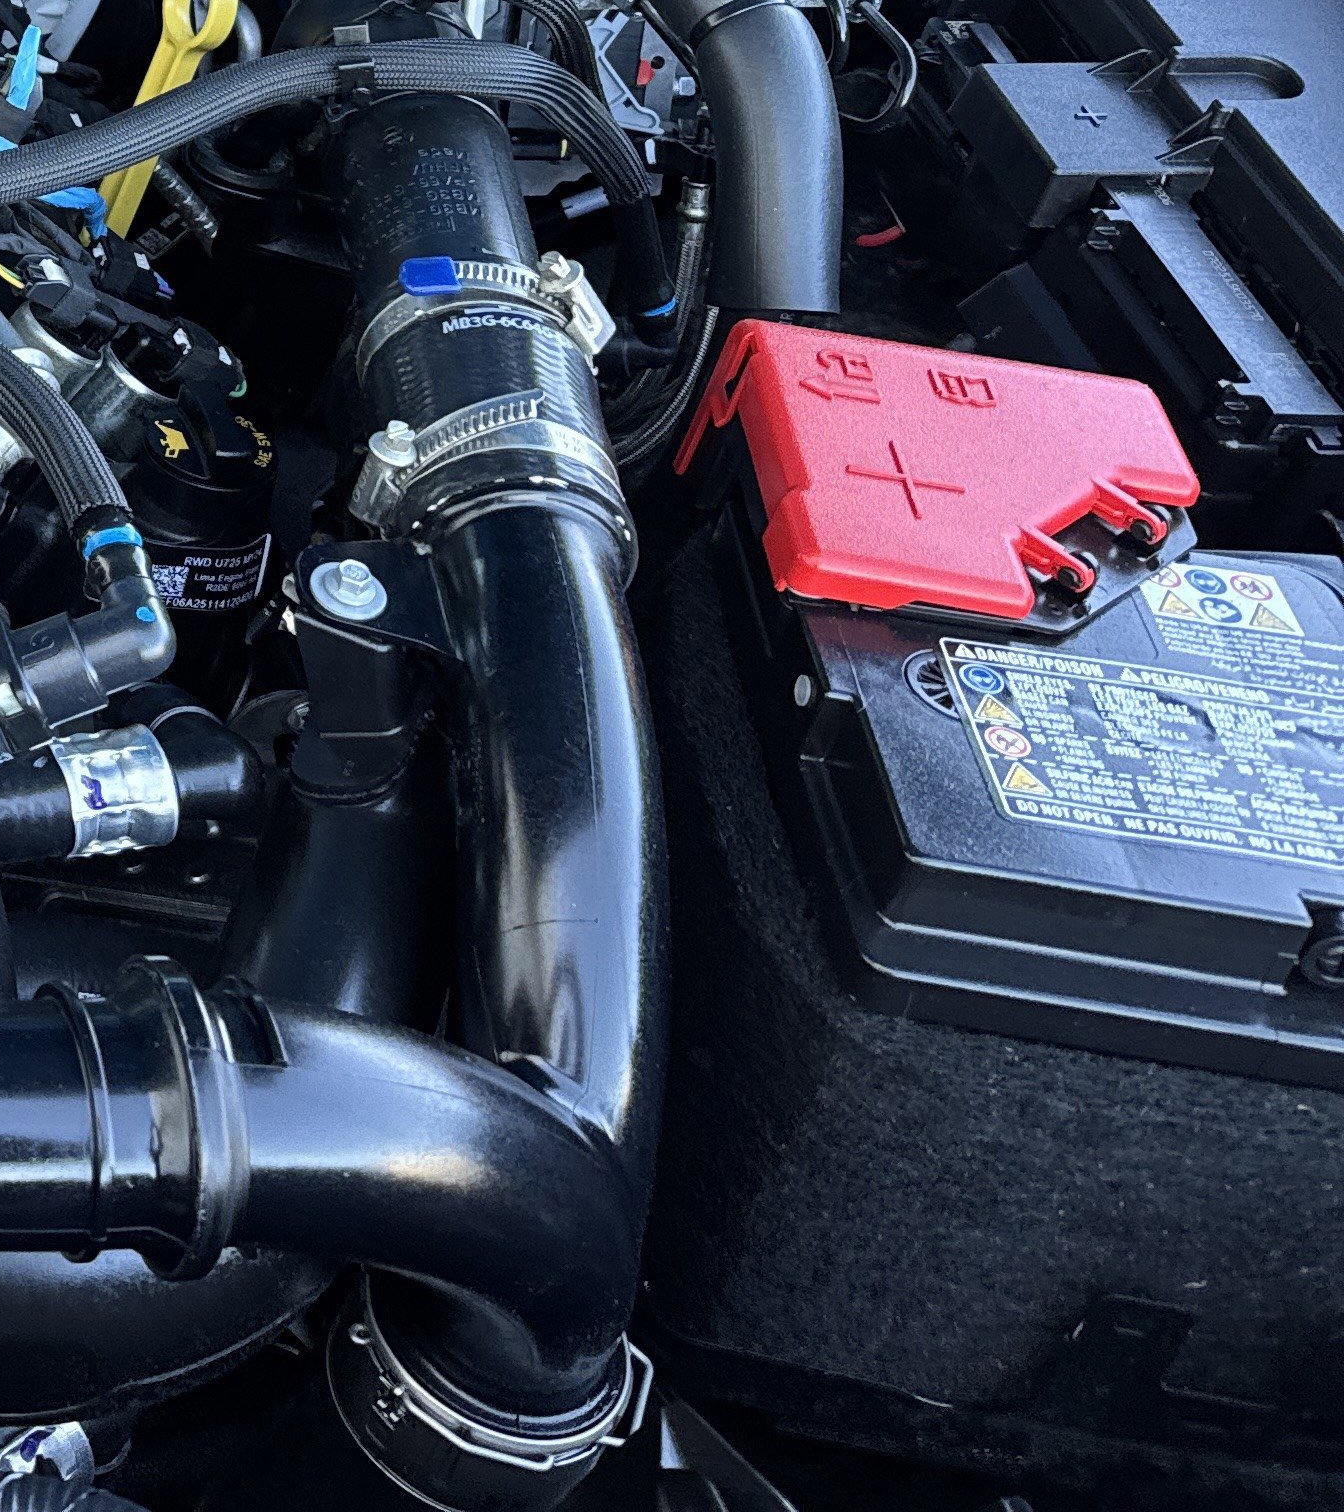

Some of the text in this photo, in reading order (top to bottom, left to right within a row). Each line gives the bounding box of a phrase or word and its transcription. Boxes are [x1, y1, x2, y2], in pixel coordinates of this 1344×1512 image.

[253, 449, 273, 468] SAE
[184, 556, 213, 568] RWD
[215, 557, 242, 568] U725
[194, 573, 216, 582] Lima
[974, 647, 1104, 678] DANGER/POISON
[1140, 671, 1270, 704] PELIGRO/VENENO
[1016, 799, 1038, 814] DO
[1040, 803, 1070, 819] NOT
[1072, 809, 1120, 828] OPEN.
[1124, 817, 1147, 831] NE
[1146, 819, 1179, 836] PAS
[1248, 836, 1273, 851] NO
[1273, 839, 1295, 854] LA
